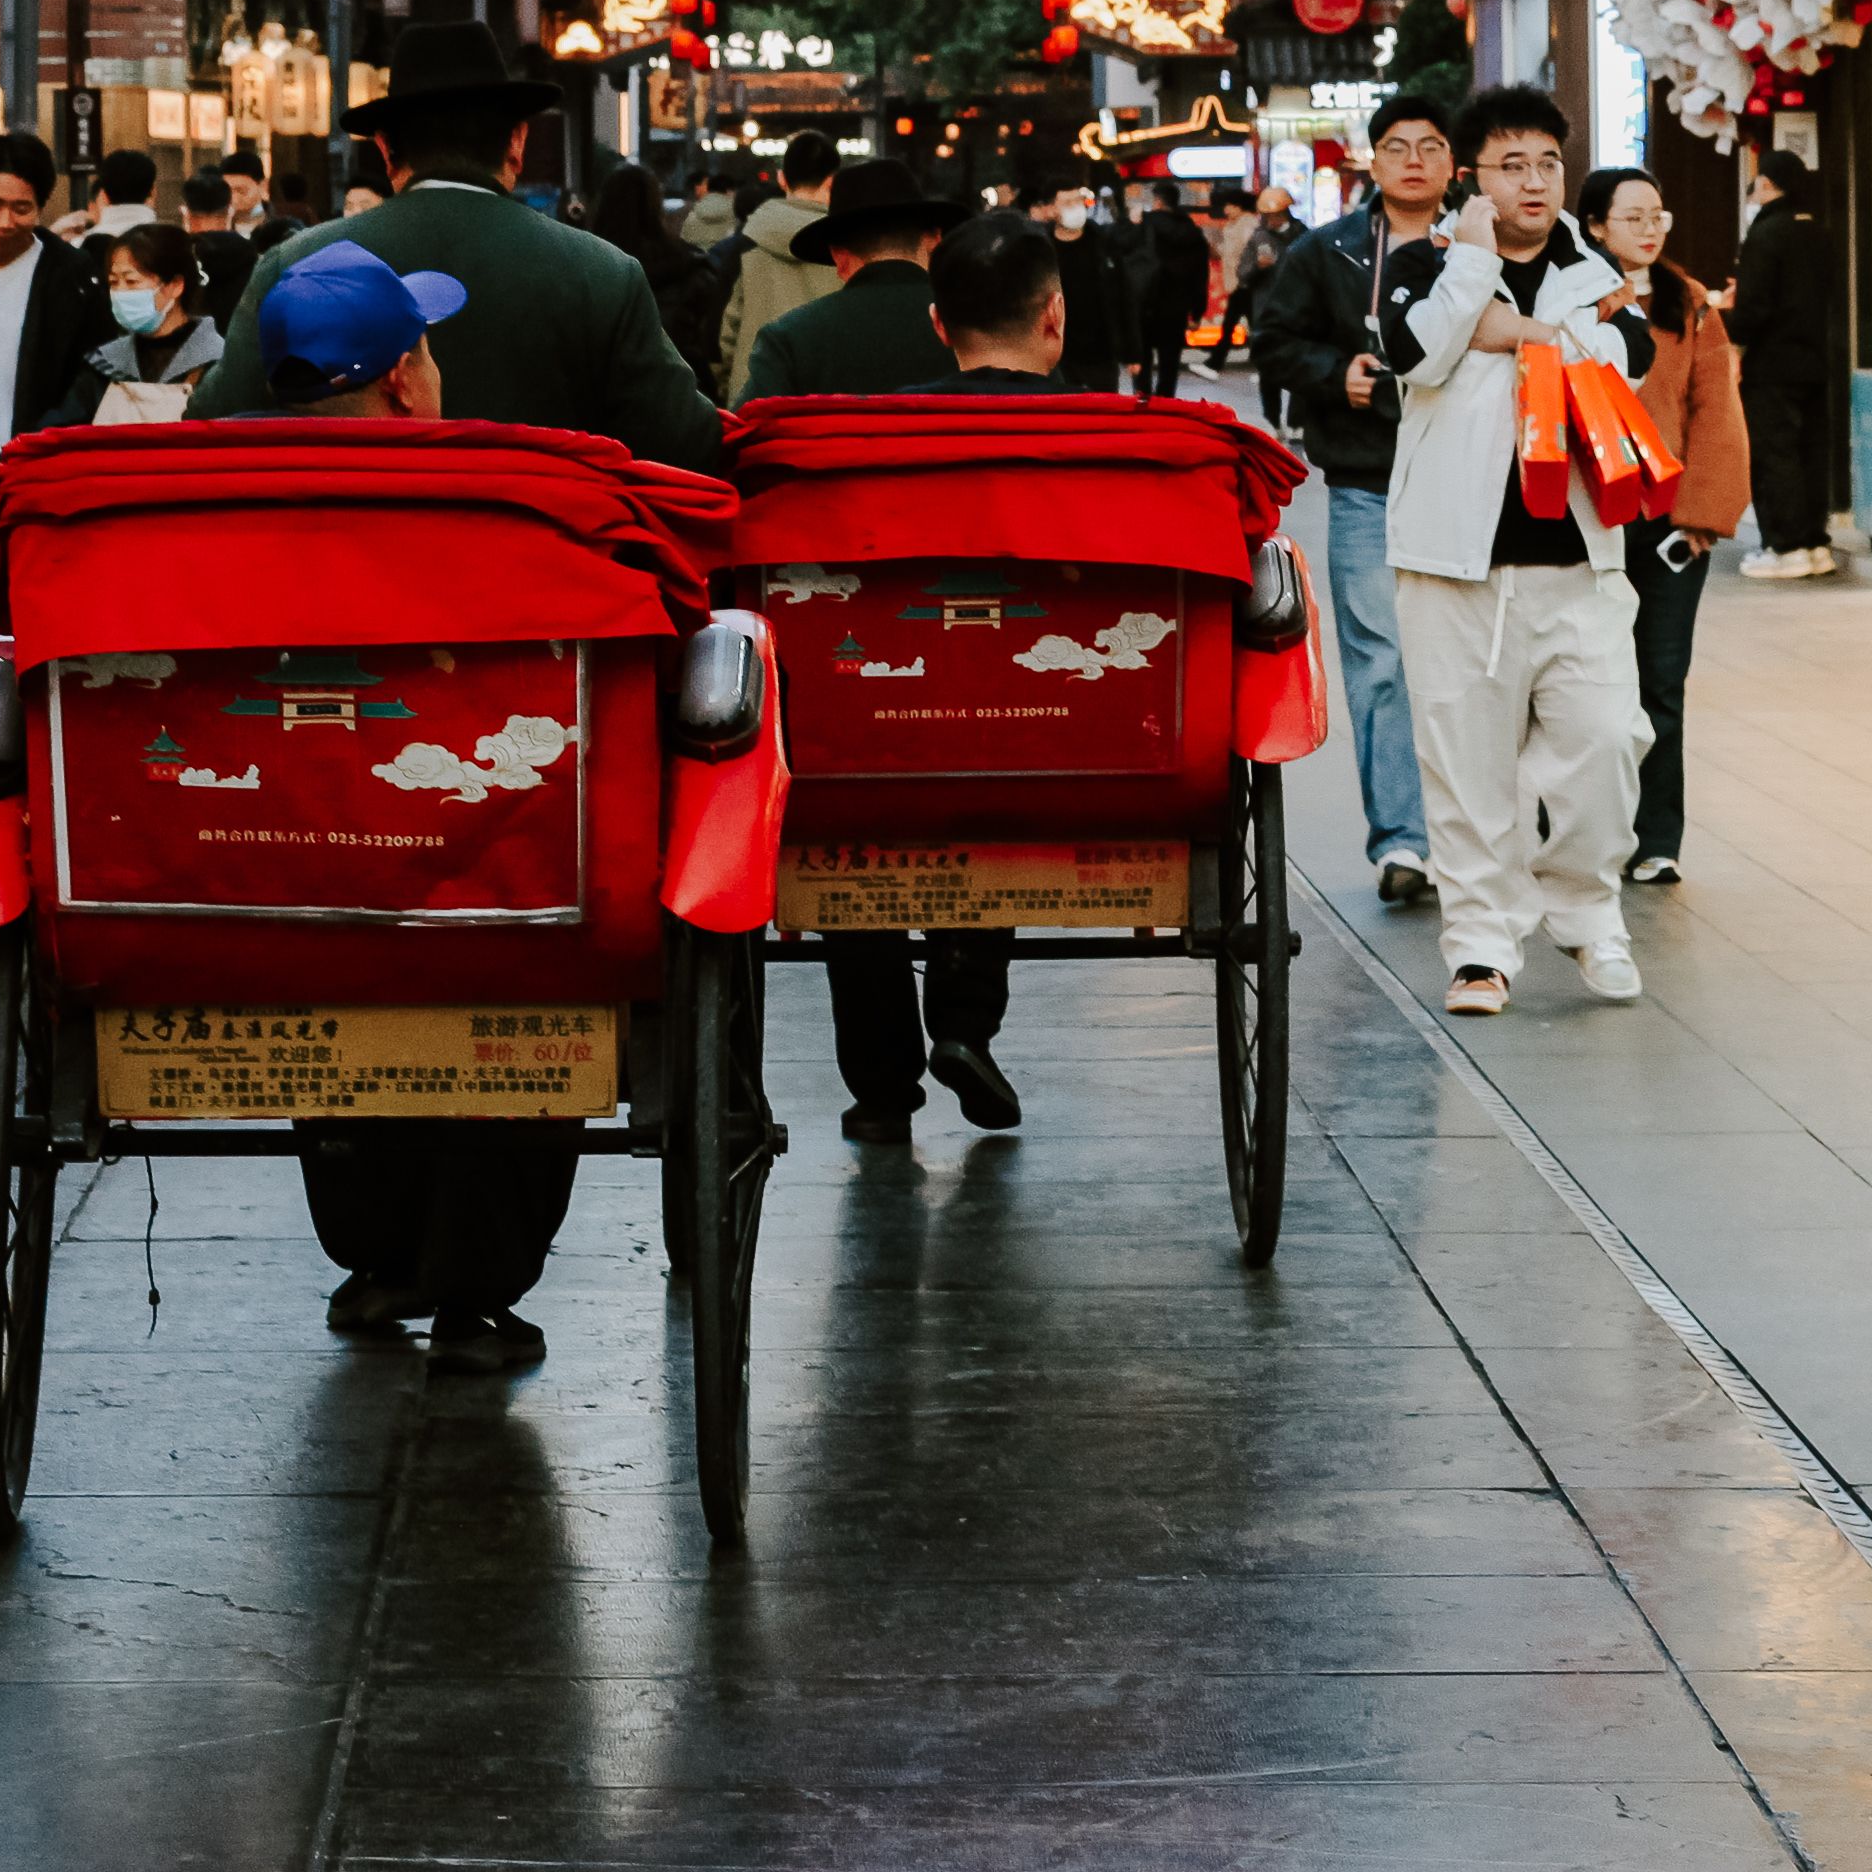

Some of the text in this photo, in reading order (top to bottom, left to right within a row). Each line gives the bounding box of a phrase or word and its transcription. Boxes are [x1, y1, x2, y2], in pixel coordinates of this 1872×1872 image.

[327, 831, 445, 847] 025-52209788
[469, 1015, 594, 1038] 旅游观光车
